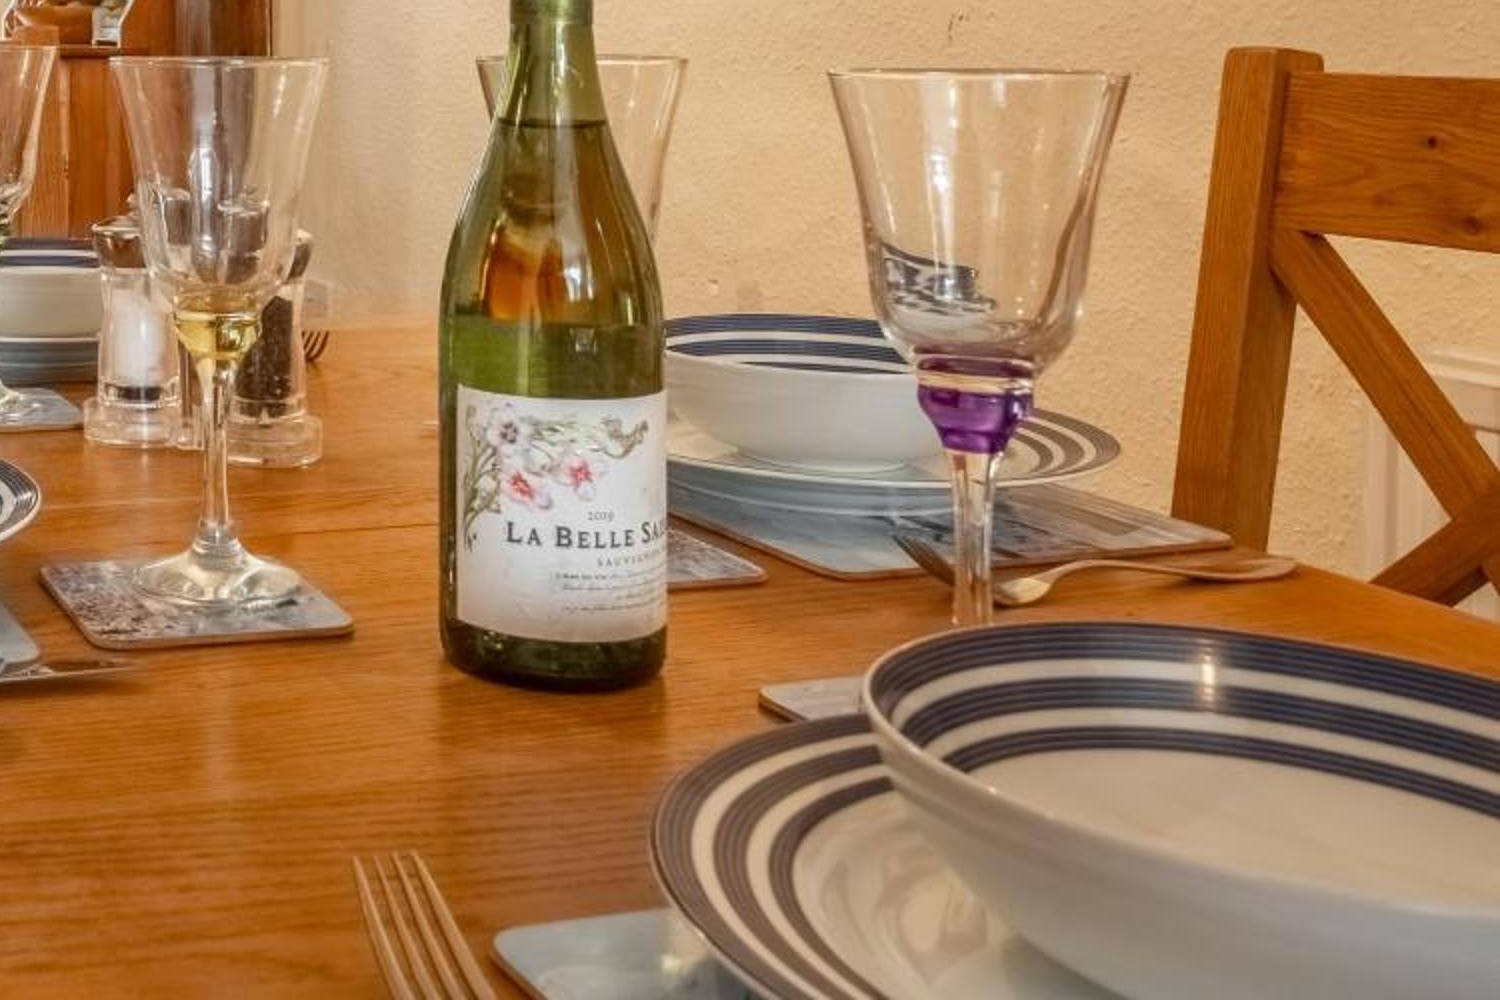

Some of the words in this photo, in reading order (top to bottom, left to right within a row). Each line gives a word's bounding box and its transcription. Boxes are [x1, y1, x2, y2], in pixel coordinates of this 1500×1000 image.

[505, 521, 542, 547] LA
[555, 525, 635, 549] BELLE
[641, 520, 666, 544] SA
